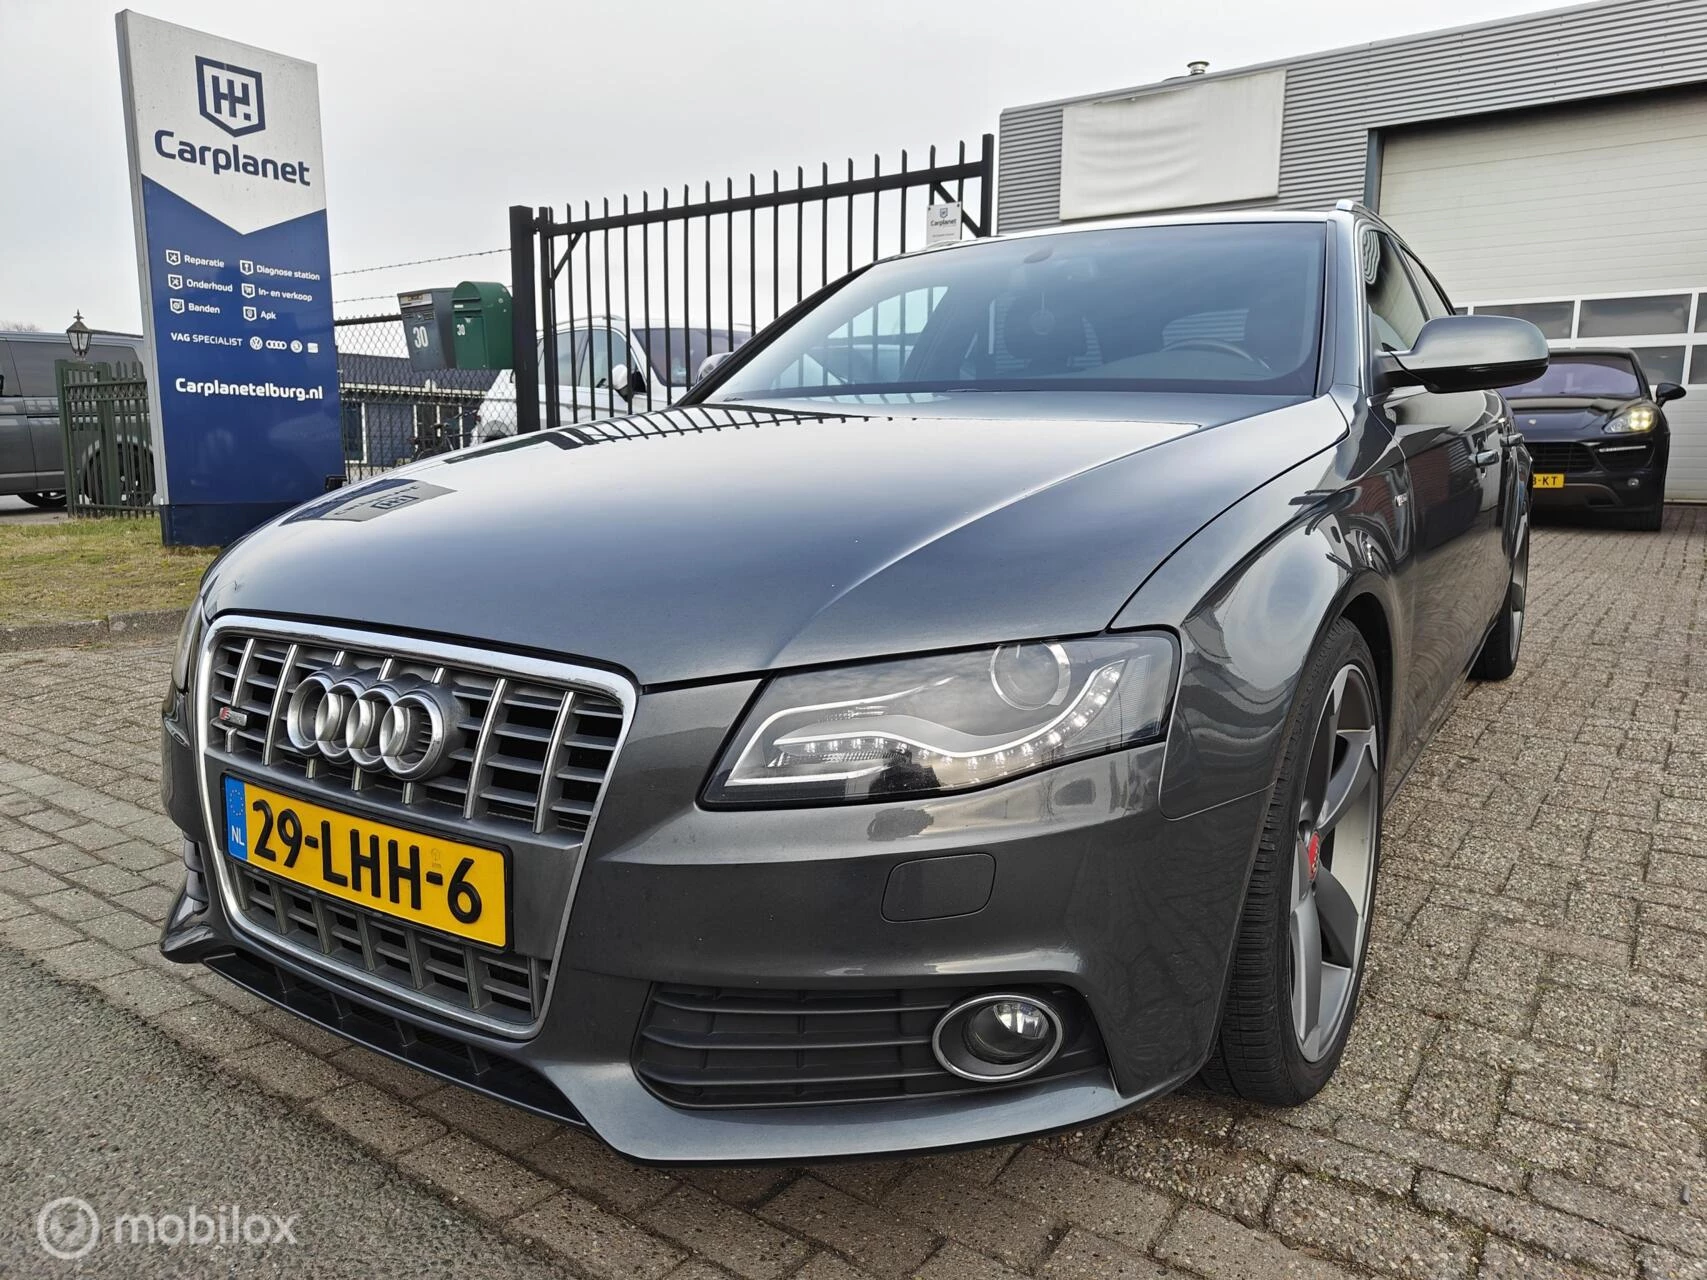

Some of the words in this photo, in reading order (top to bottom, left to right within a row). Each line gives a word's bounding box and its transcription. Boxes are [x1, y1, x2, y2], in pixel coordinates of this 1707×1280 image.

[154, 129, 310, 186] Carplanet
[184, 254, 225, 268] Reparatie
[256, 264, 293, 279] Diagnose
[294, 271, 320, 280] station
[186, 278, 233, 293] Onderhoud
[258, 288, 269, 296] In-
[282, 292, 312, 302] verkoop
[188, 303, 220, 314] Banden
[260, 311, 277, 320] Apk
[413, 326, 429, 348] 30
[457, 324, 466, 335] 30
[170, 332, 191, 342] VAG
[192, 334, 243, 346] SPECIALIST
[175, 377, 323, 401] Carplanetelburg.nl
[231, 824, 246, 847] NL
[252, 799, 483, 925] 29-LHH-6
